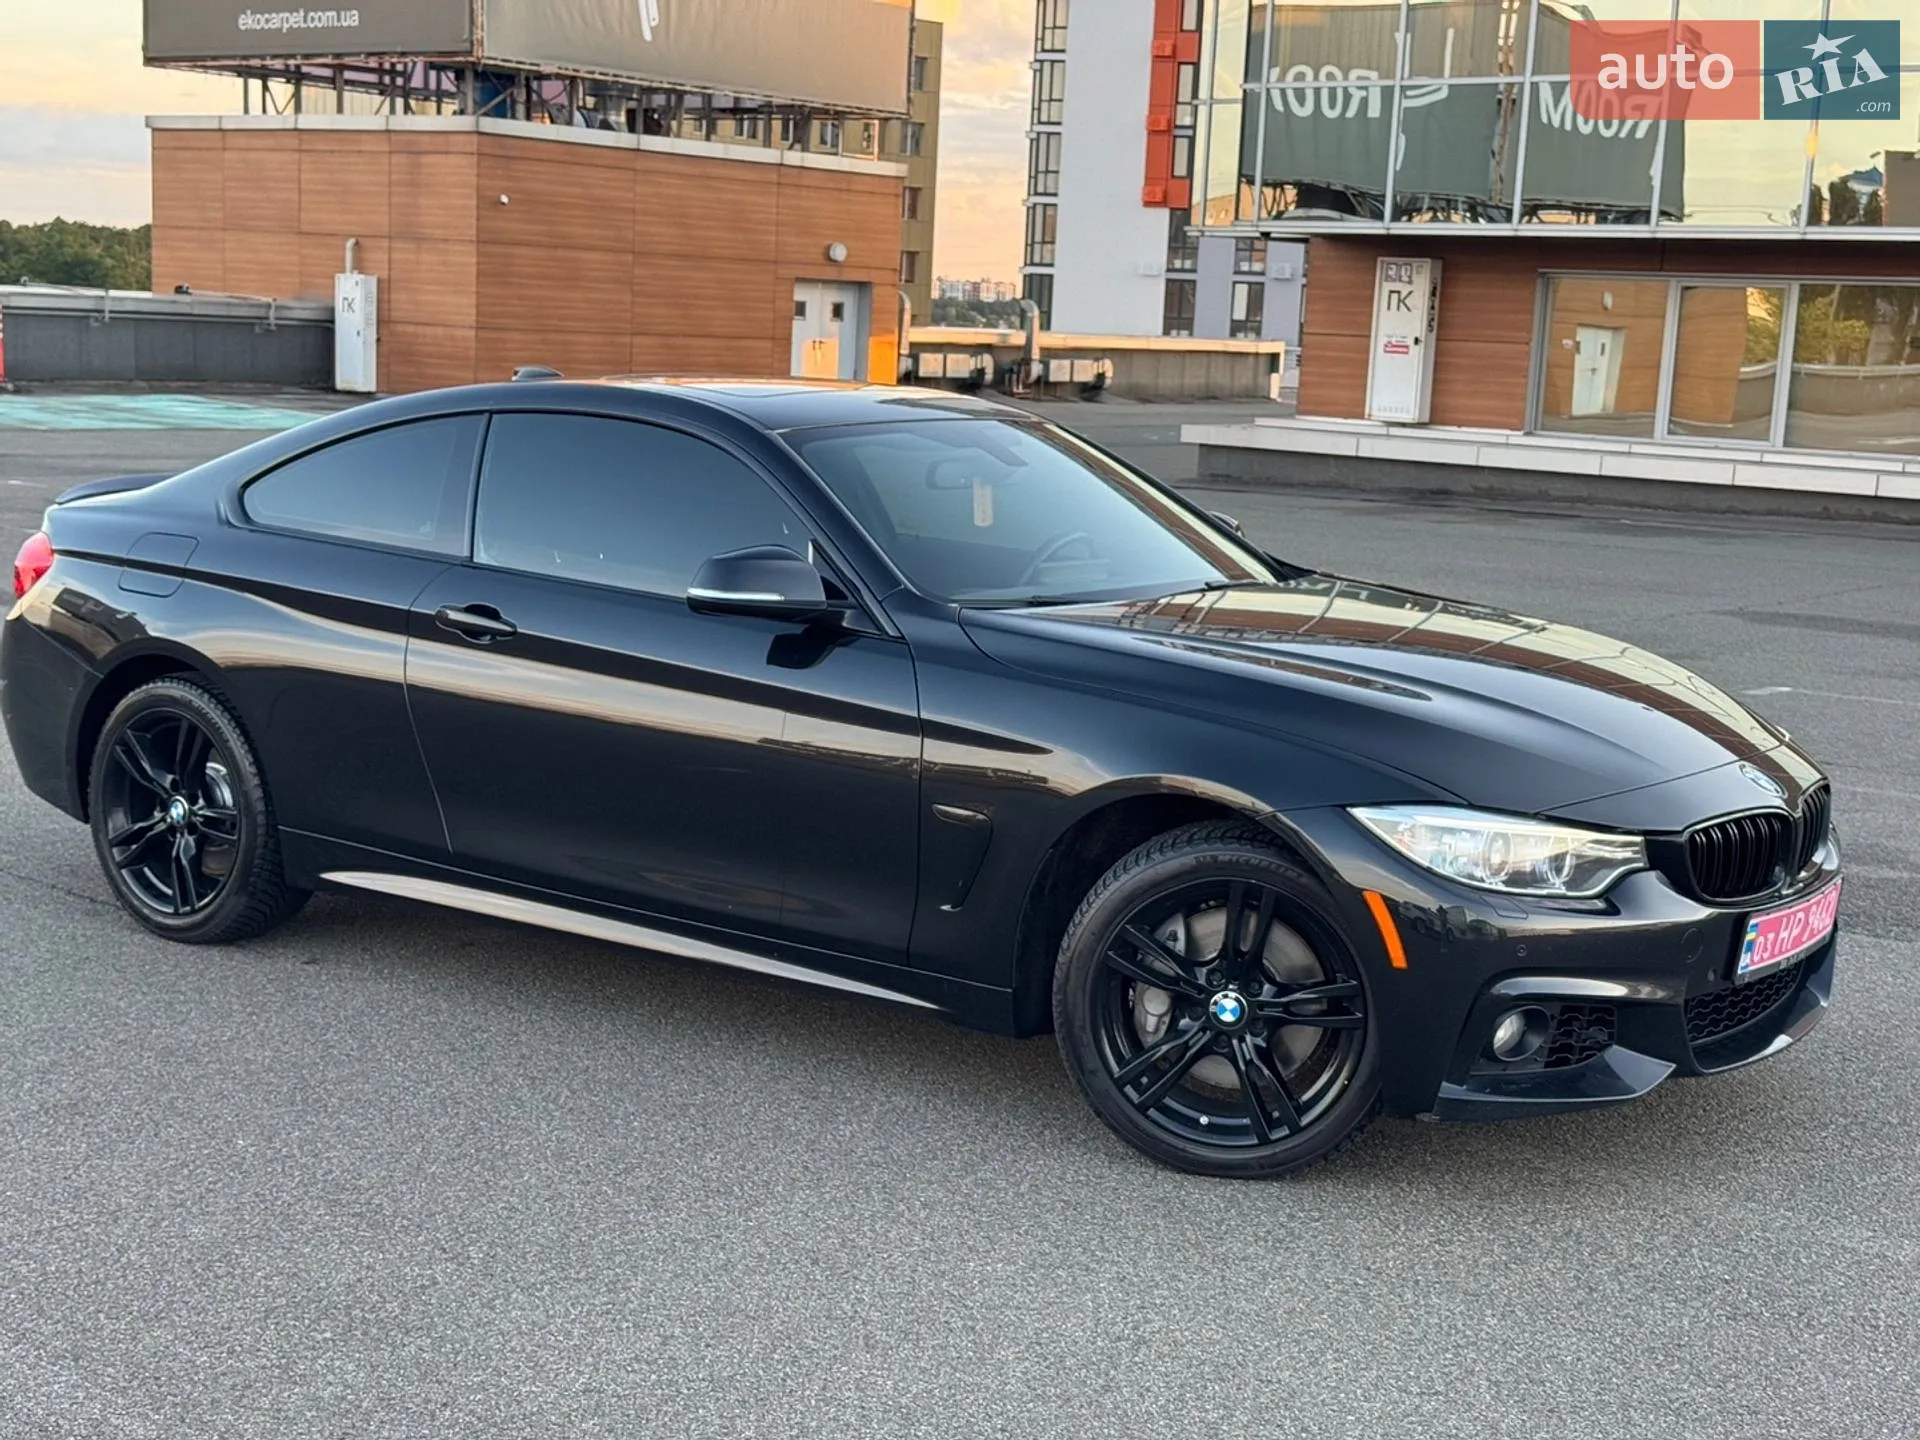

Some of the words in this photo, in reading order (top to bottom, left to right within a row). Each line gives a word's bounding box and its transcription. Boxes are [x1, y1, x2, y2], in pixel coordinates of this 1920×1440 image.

[238, 8, 359, 33] ekocarpet.com.ua
[1387, 290, 1413, 312] ПК
[1774, 911, 1805, 955] HP
